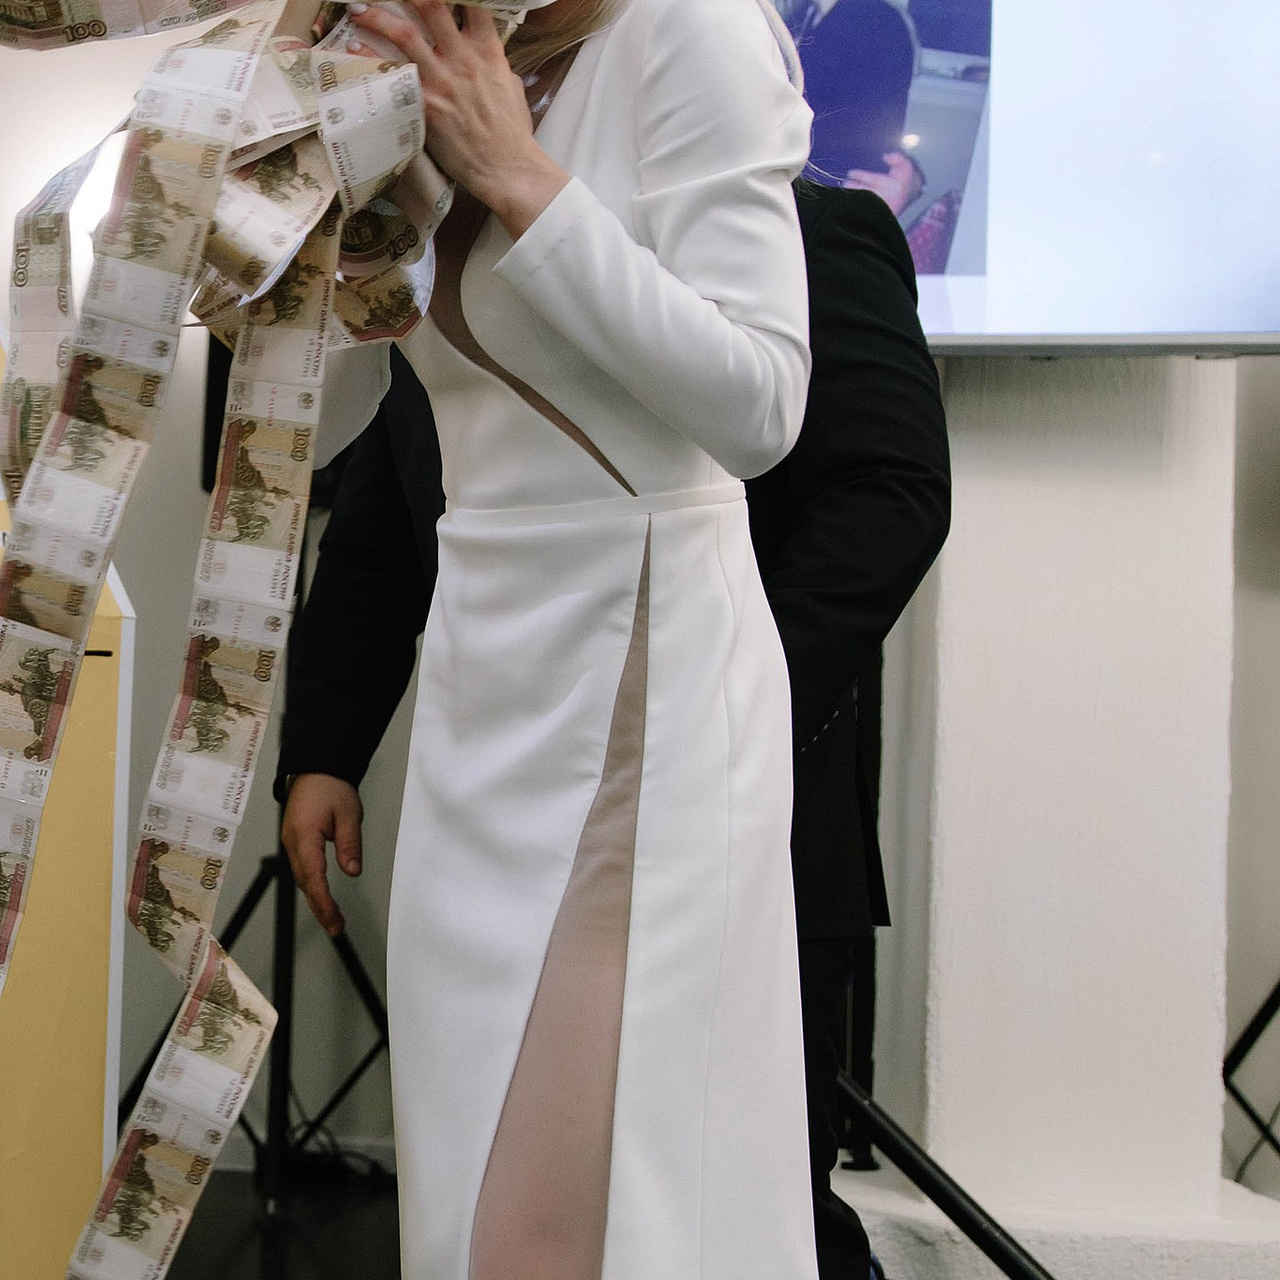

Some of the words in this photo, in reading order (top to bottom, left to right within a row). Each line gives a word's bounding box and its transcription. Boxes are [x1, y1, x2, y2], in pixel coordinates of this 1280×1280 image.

[63, 21, 107, 42] 100
[317, 60, 338, 92] 100
[202, 143, 222, 178] 100
[386, 225, 419, 261] 100
[14, 241, 31, 287] 100
[137, 374, 161, 407] 100
[291, 428, 311, 462] 100
[254, 648, 276, 683] 100
[200, 857, 222, 891] 100
[185, 1155, 210, 1186] 100
